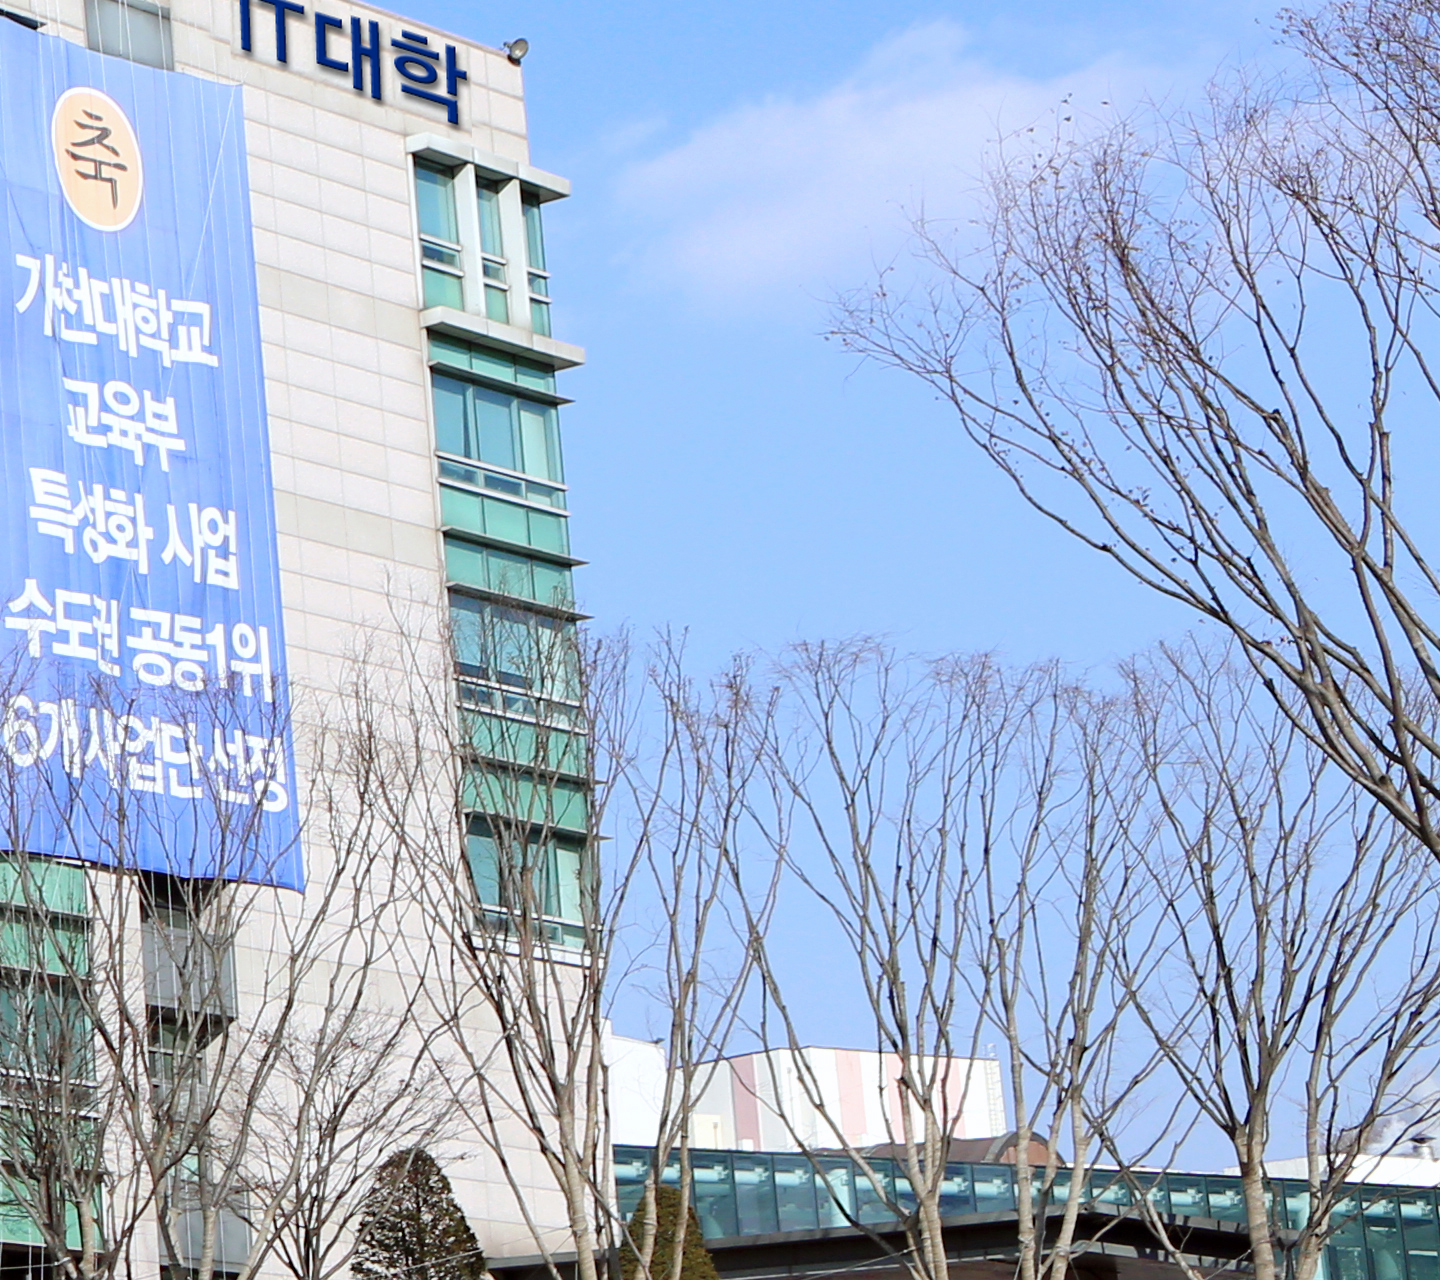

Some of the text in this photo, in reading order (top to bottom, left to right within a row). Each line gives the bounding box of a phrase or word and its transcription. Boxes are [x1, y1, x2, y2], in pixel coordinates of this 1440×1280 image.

[65, 108, 128, 210] 축
[15, 252, 219, 369] 가천대학교
[62, 376, 186, 472] 교육부
[29, 467, 240, 590] 특성화 사업
[4, 578, 274, 704] 수도권 공동1위
